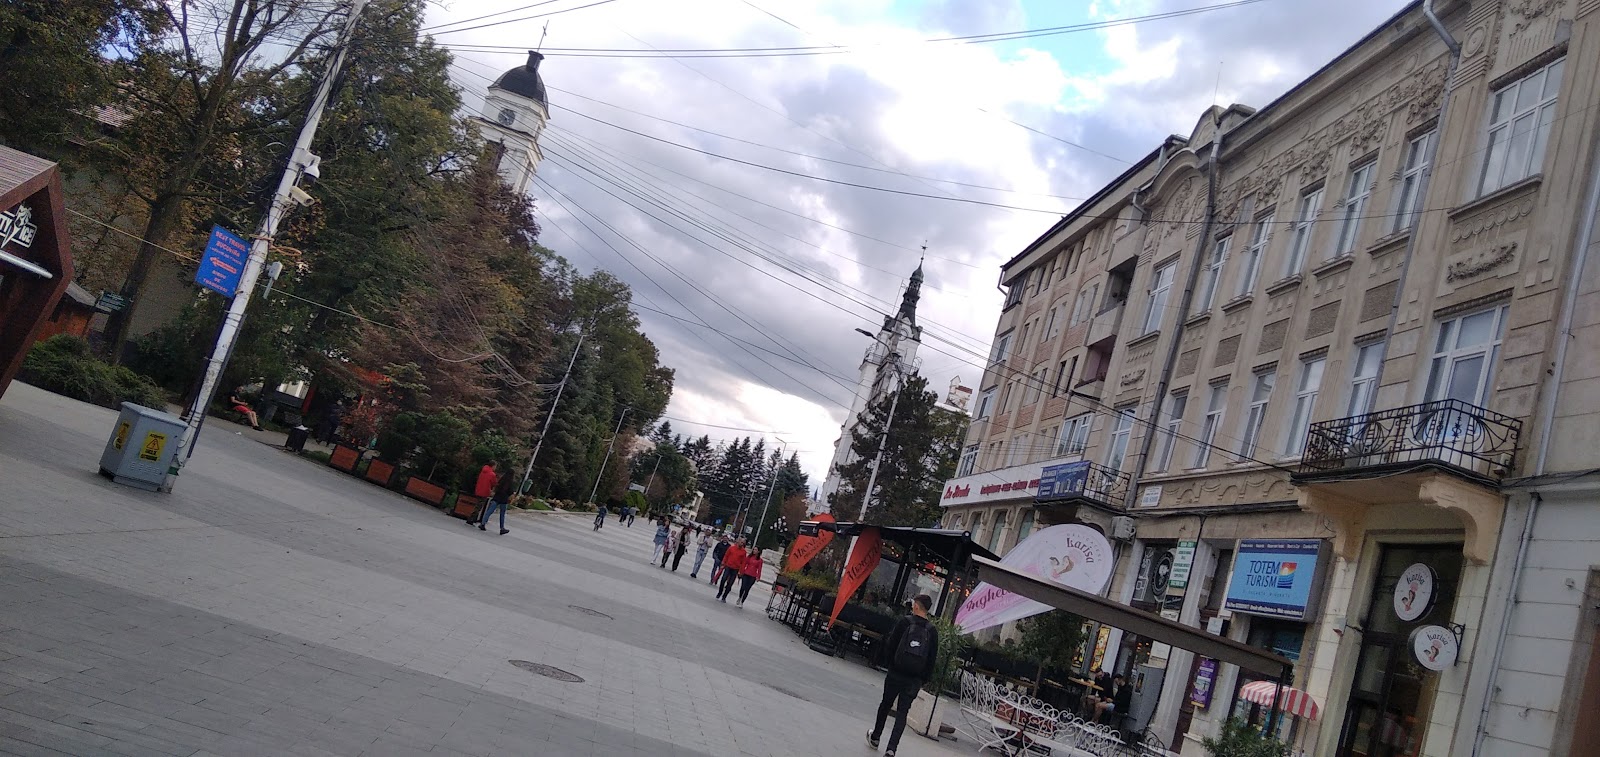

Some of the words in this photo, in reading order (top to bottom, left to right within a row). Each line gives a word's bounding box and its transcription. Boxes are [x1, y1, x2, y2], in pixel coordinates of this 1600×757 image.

[19, 225, 35, 243] ICE
[1249, 560, 1280, 575] TOTEM
[1246, 574, 1277, 588] TURISM
